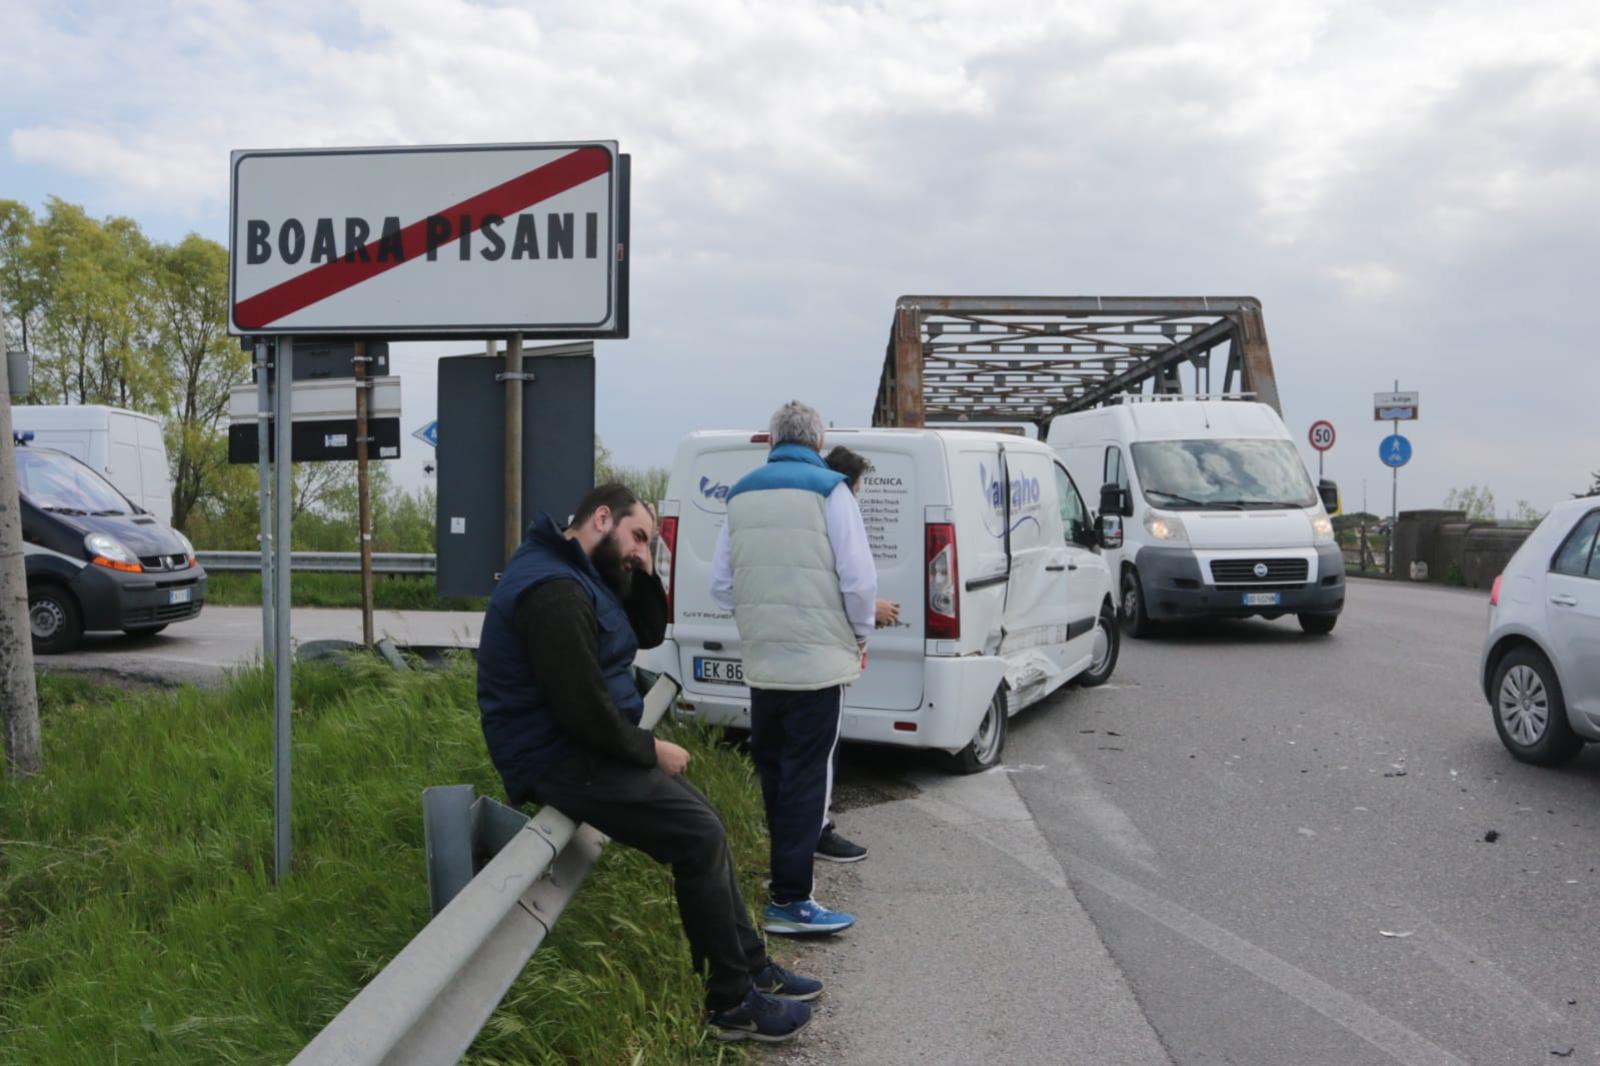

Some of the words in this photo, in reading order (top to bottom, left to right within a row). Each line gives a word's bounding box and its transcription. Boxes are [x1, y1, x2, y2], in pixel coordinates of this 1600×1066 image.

[247, 216, 405, 265] BOARA
[426, 212, 598, 262] PISANI
[1315, 428, 1330, 443] 50
[863, 476, 903, 486] TECNICA
[703, 661, 721, 678] EK
